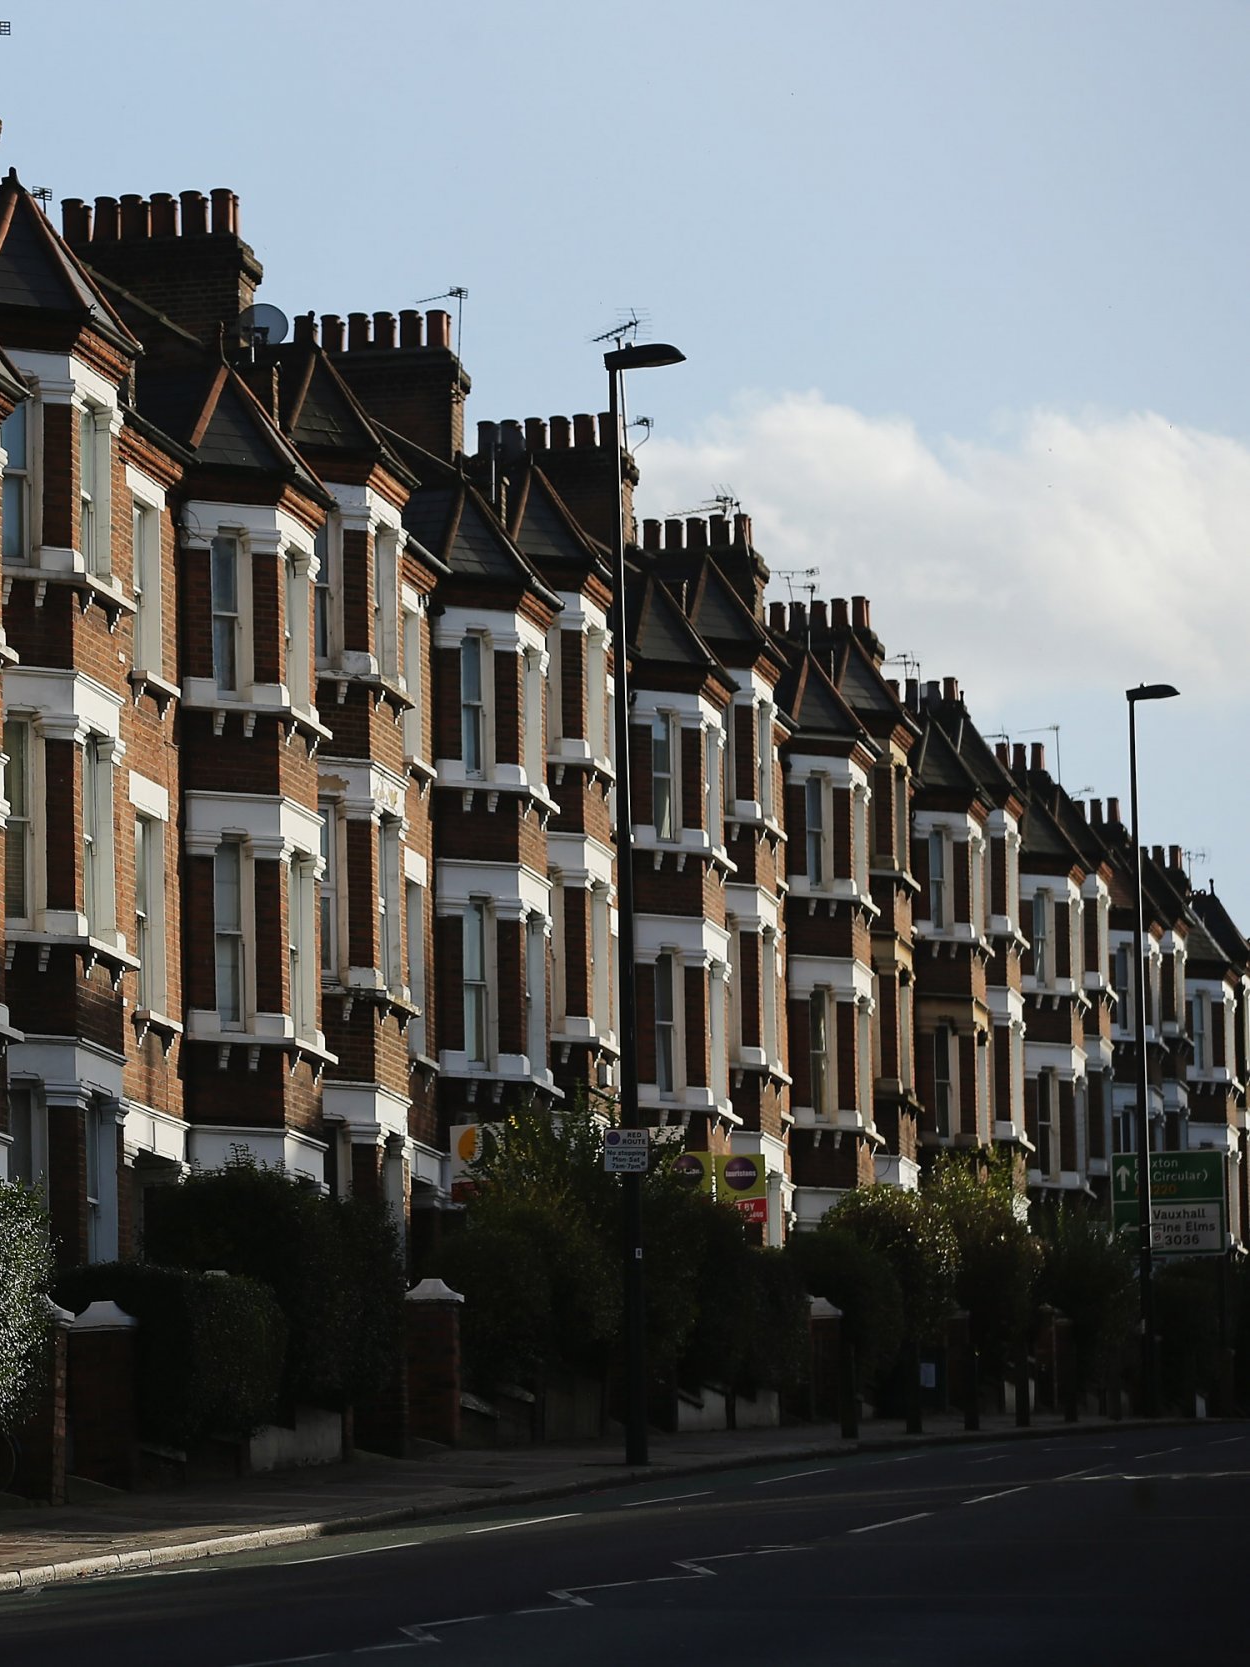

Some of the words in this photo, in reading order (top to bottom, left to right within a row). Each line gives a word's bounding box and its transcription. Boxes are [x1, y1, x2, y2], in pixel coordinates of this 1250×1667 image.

[1134, 1158, 1179, 1169] xton
[1134, 1168, 1208, 1184] (.Circular)
[1153, 1208, 1206, 1220] Vauxhall
[1163, 1222, 1182, 1232] ine
[1185, 1221, 1216, 1232] Elms
[1164, 1234, 1200, 1245] 3036
